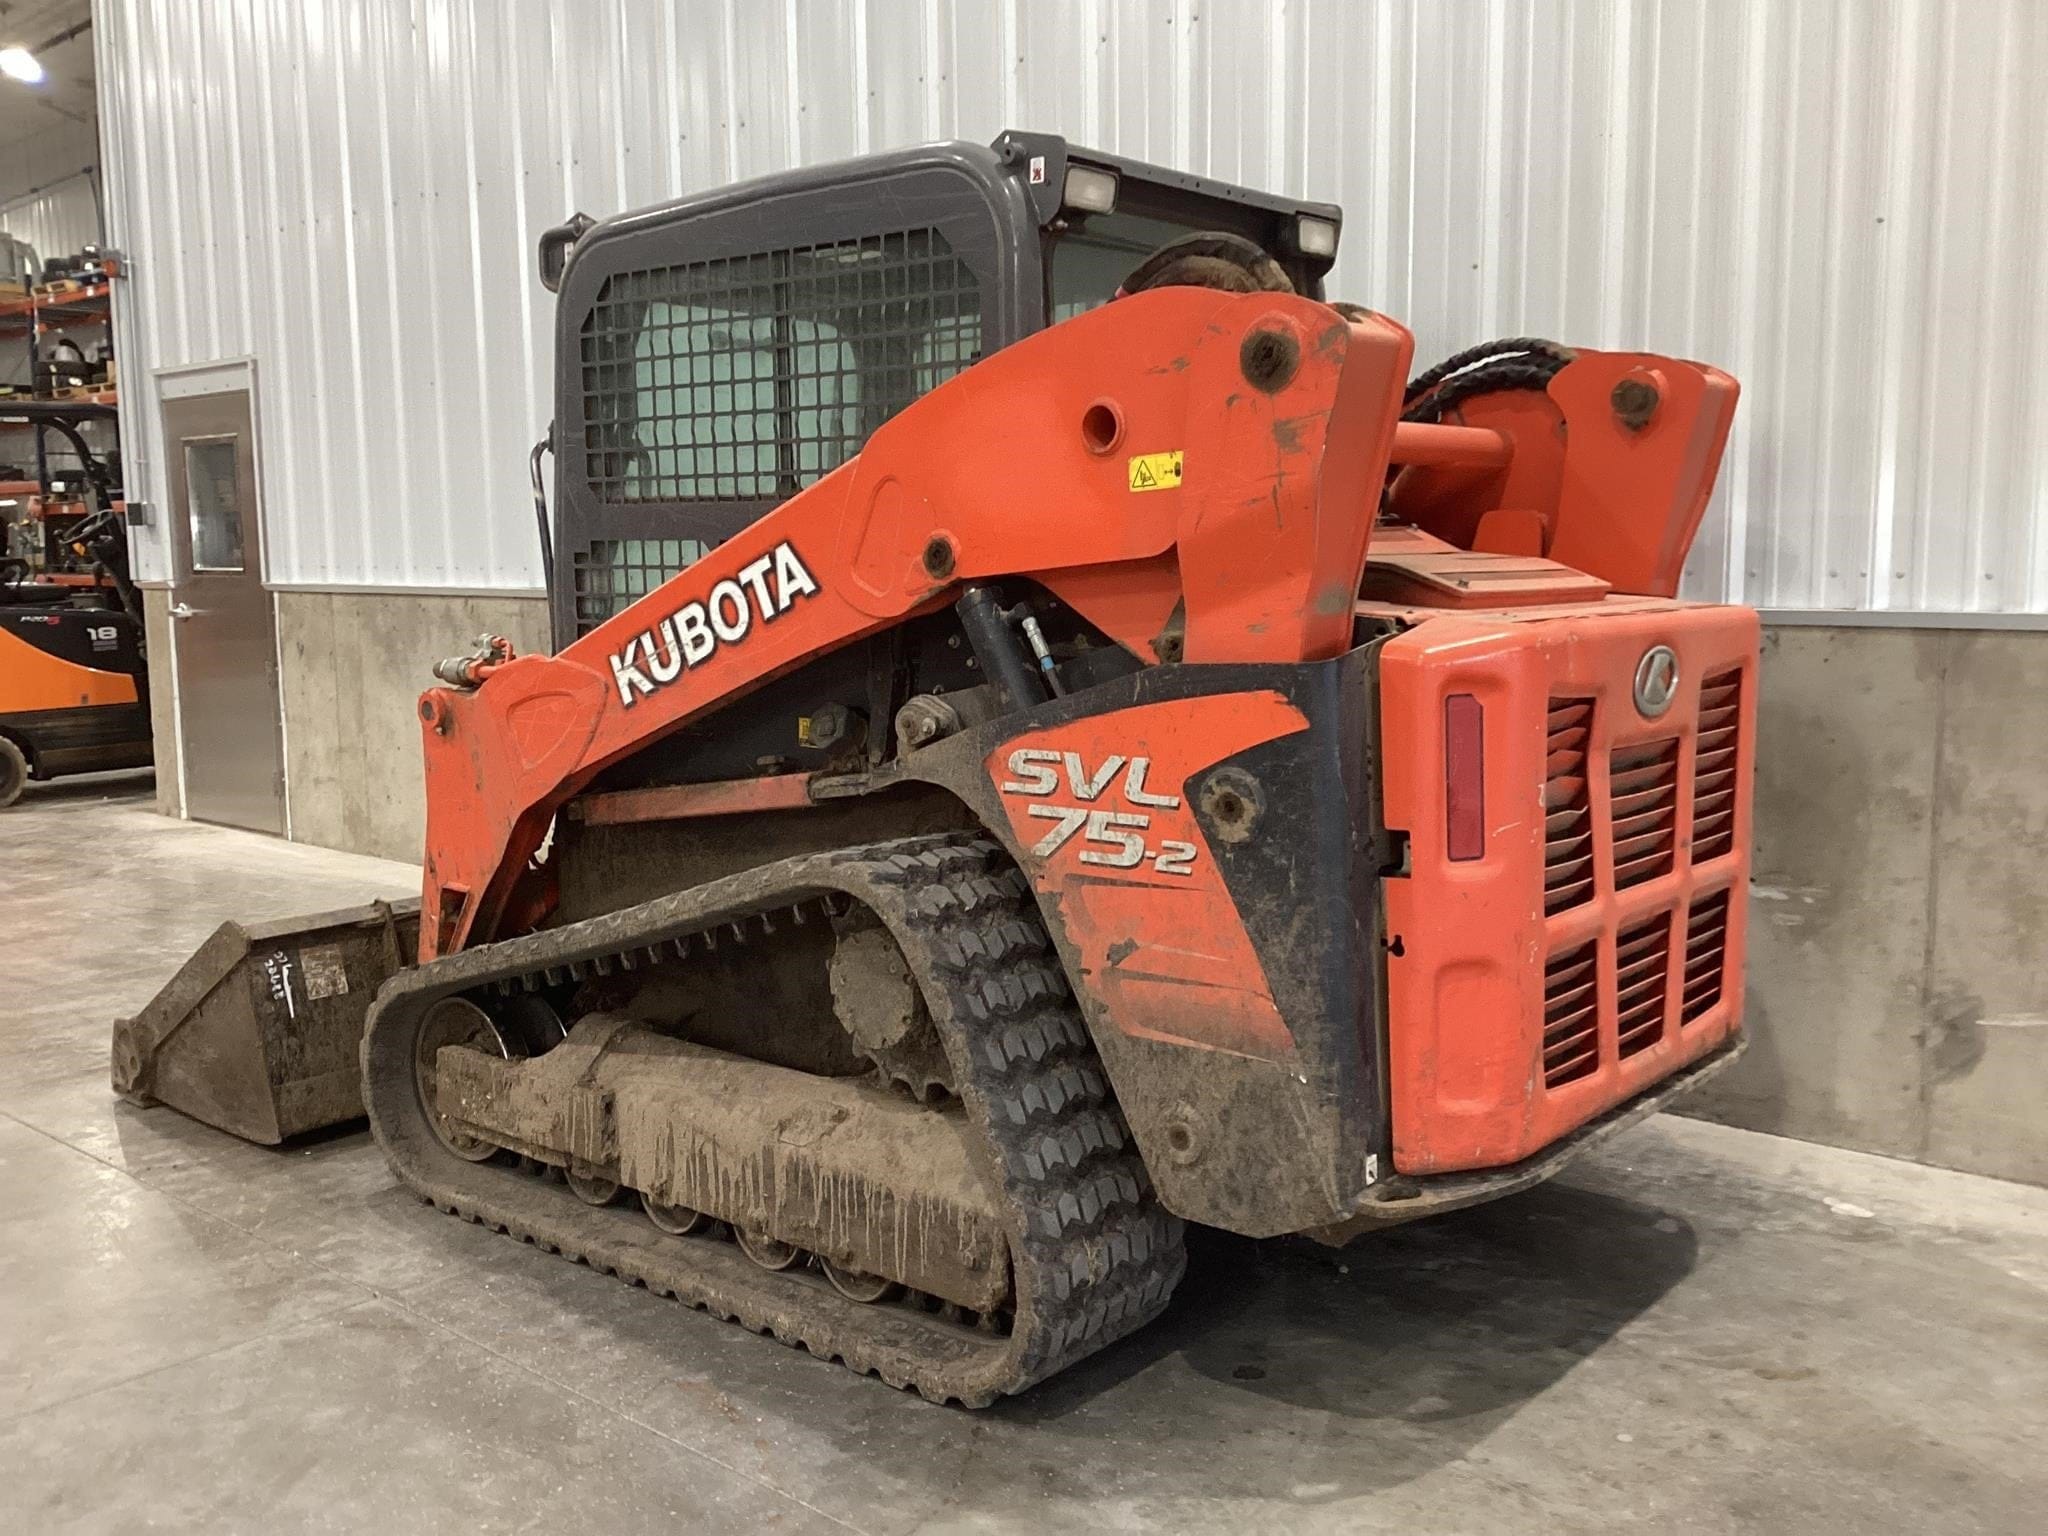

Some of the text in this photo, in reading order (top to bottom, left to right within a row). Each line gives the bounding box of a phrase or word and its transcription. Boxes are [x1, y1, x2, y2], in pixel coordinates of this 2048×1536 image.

[86, 626, 118, 641] 18
[608, 541, 818, 707] KUBOTA
[1001, 748, 1181, 808] SVL
[1028, 803, 1198, 876] 75-2
